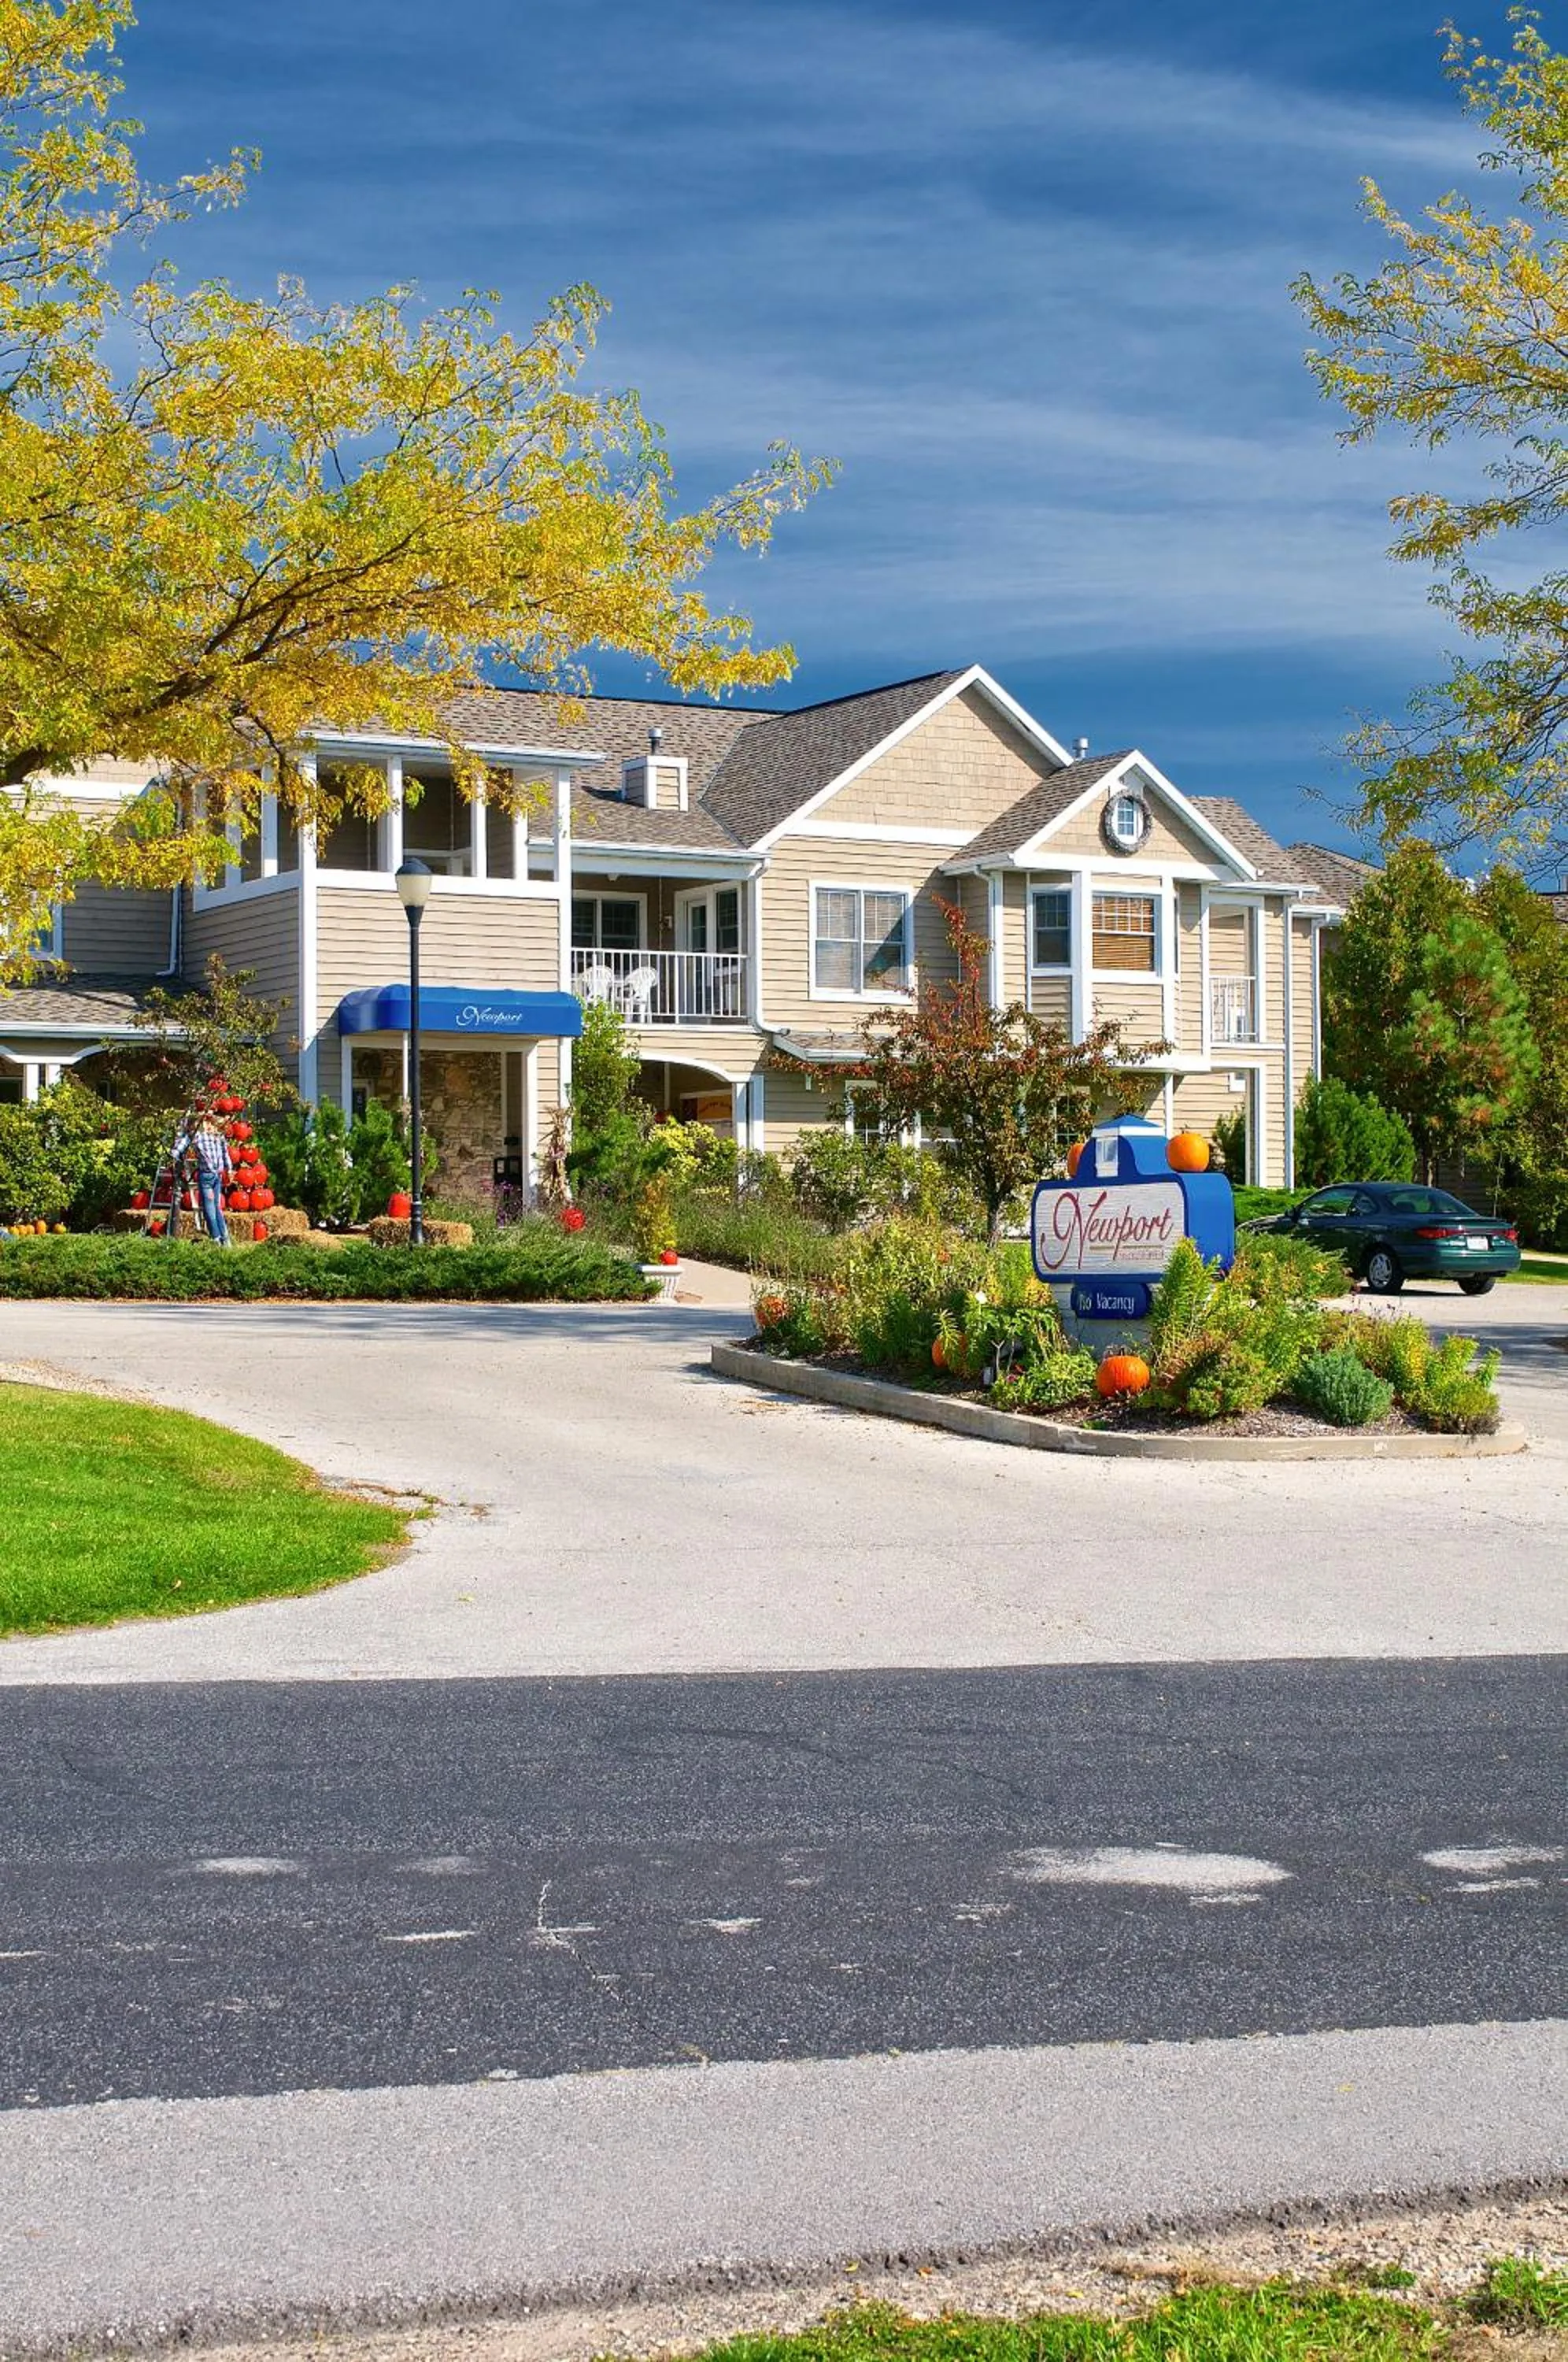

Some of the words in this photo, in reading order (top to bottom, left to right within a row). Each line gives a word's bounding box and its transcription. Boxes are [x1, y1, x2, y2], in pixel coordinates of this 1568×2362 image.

[456, 1005, 523, 1026] Newport
[1040, 1190, 1174, 1270] Newport
[1096, 1292, 1134, 1314] Vacancy
